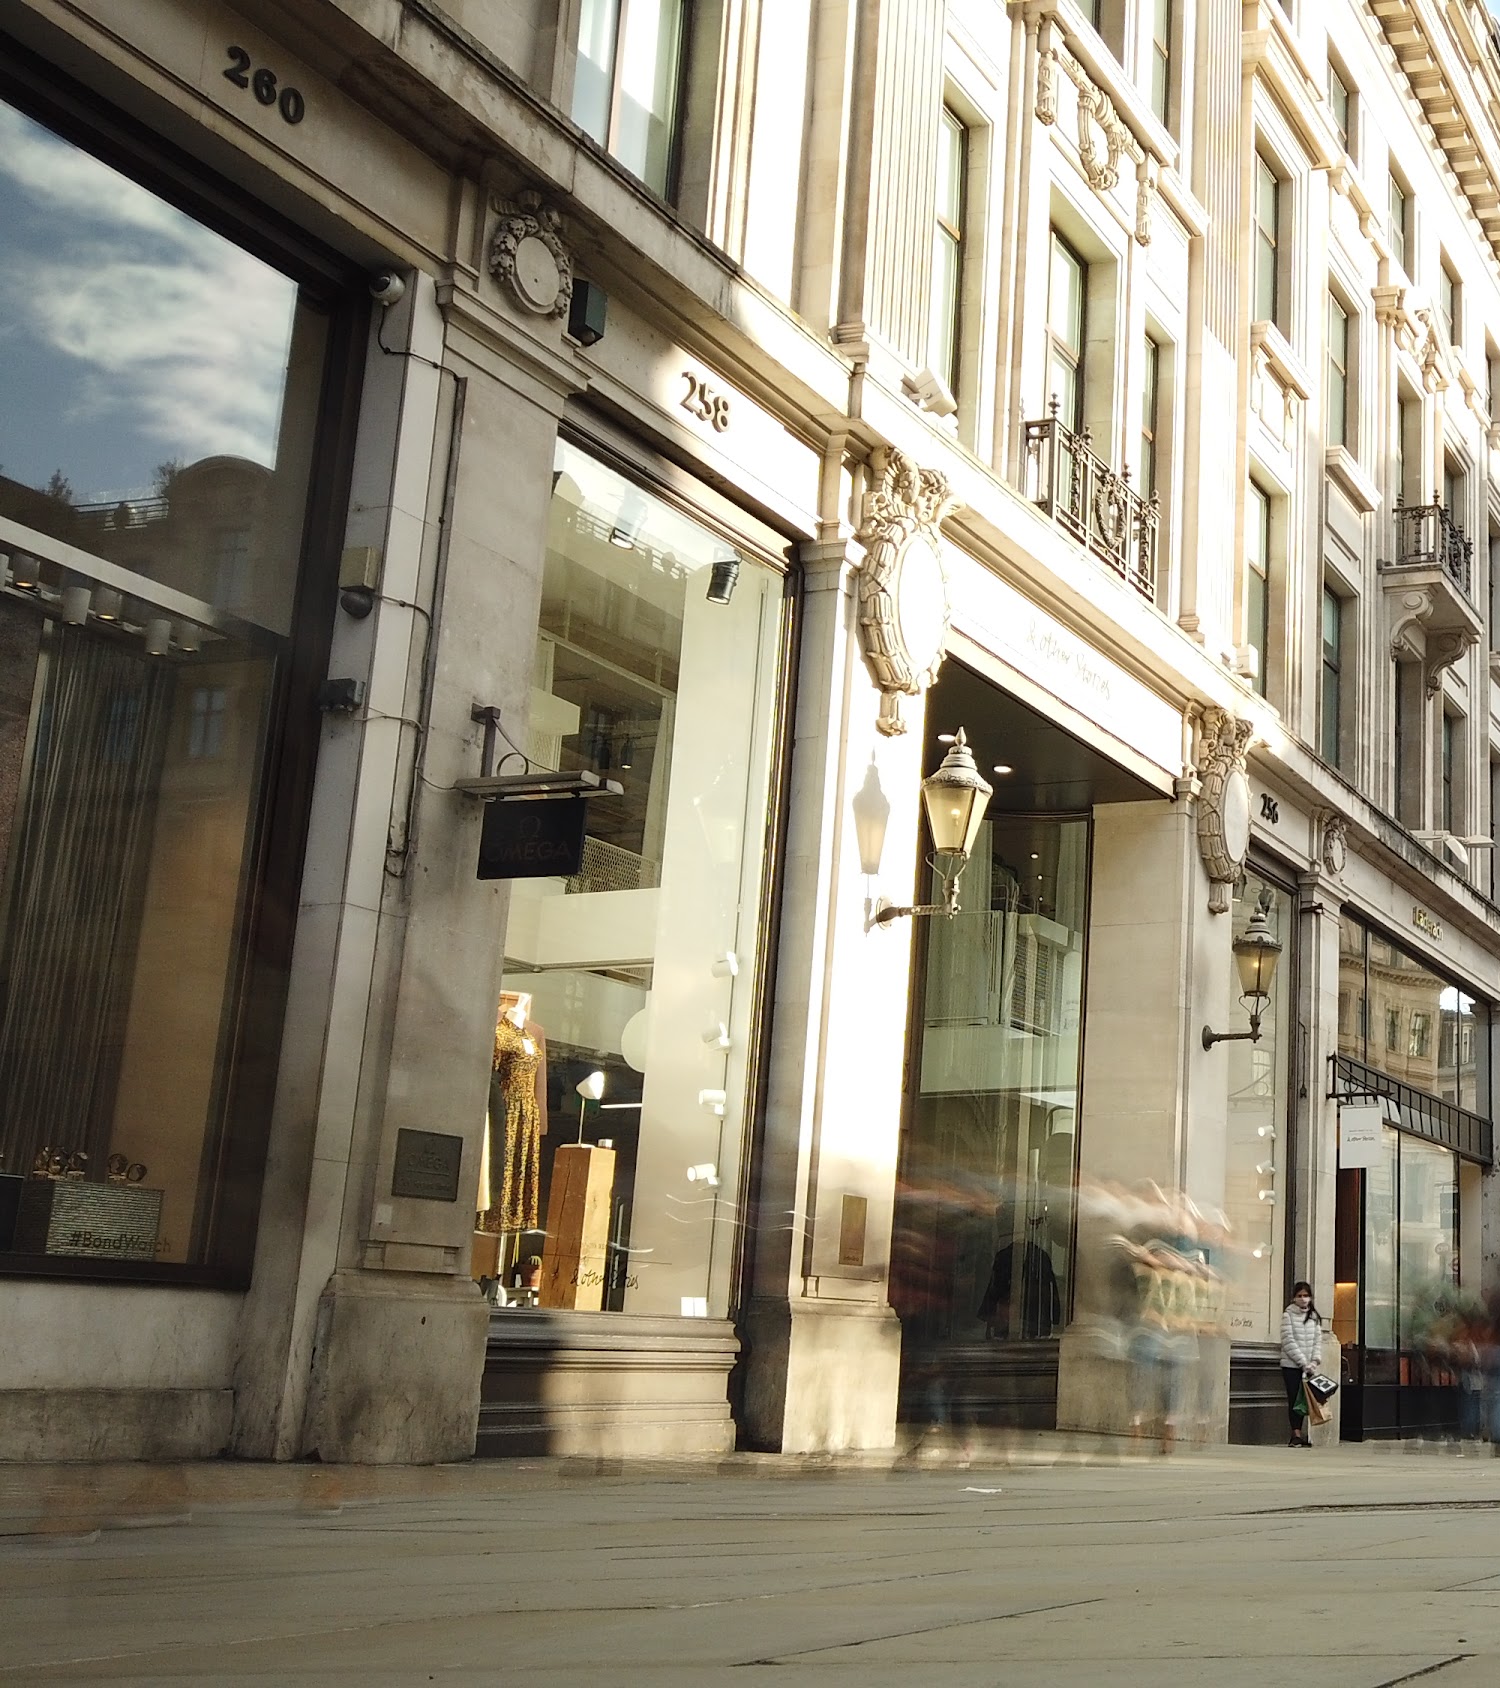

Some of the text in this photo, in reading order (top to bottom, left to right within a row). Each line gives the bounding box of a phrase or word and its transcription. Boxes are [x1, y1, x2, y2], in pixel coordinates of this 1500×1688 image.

[223, 45, 305, 125] 260
[679, 371, 731, 433] 258
[1260, 793, 1279, 824] 256
[484, 841, 572, 862] OMEGA
